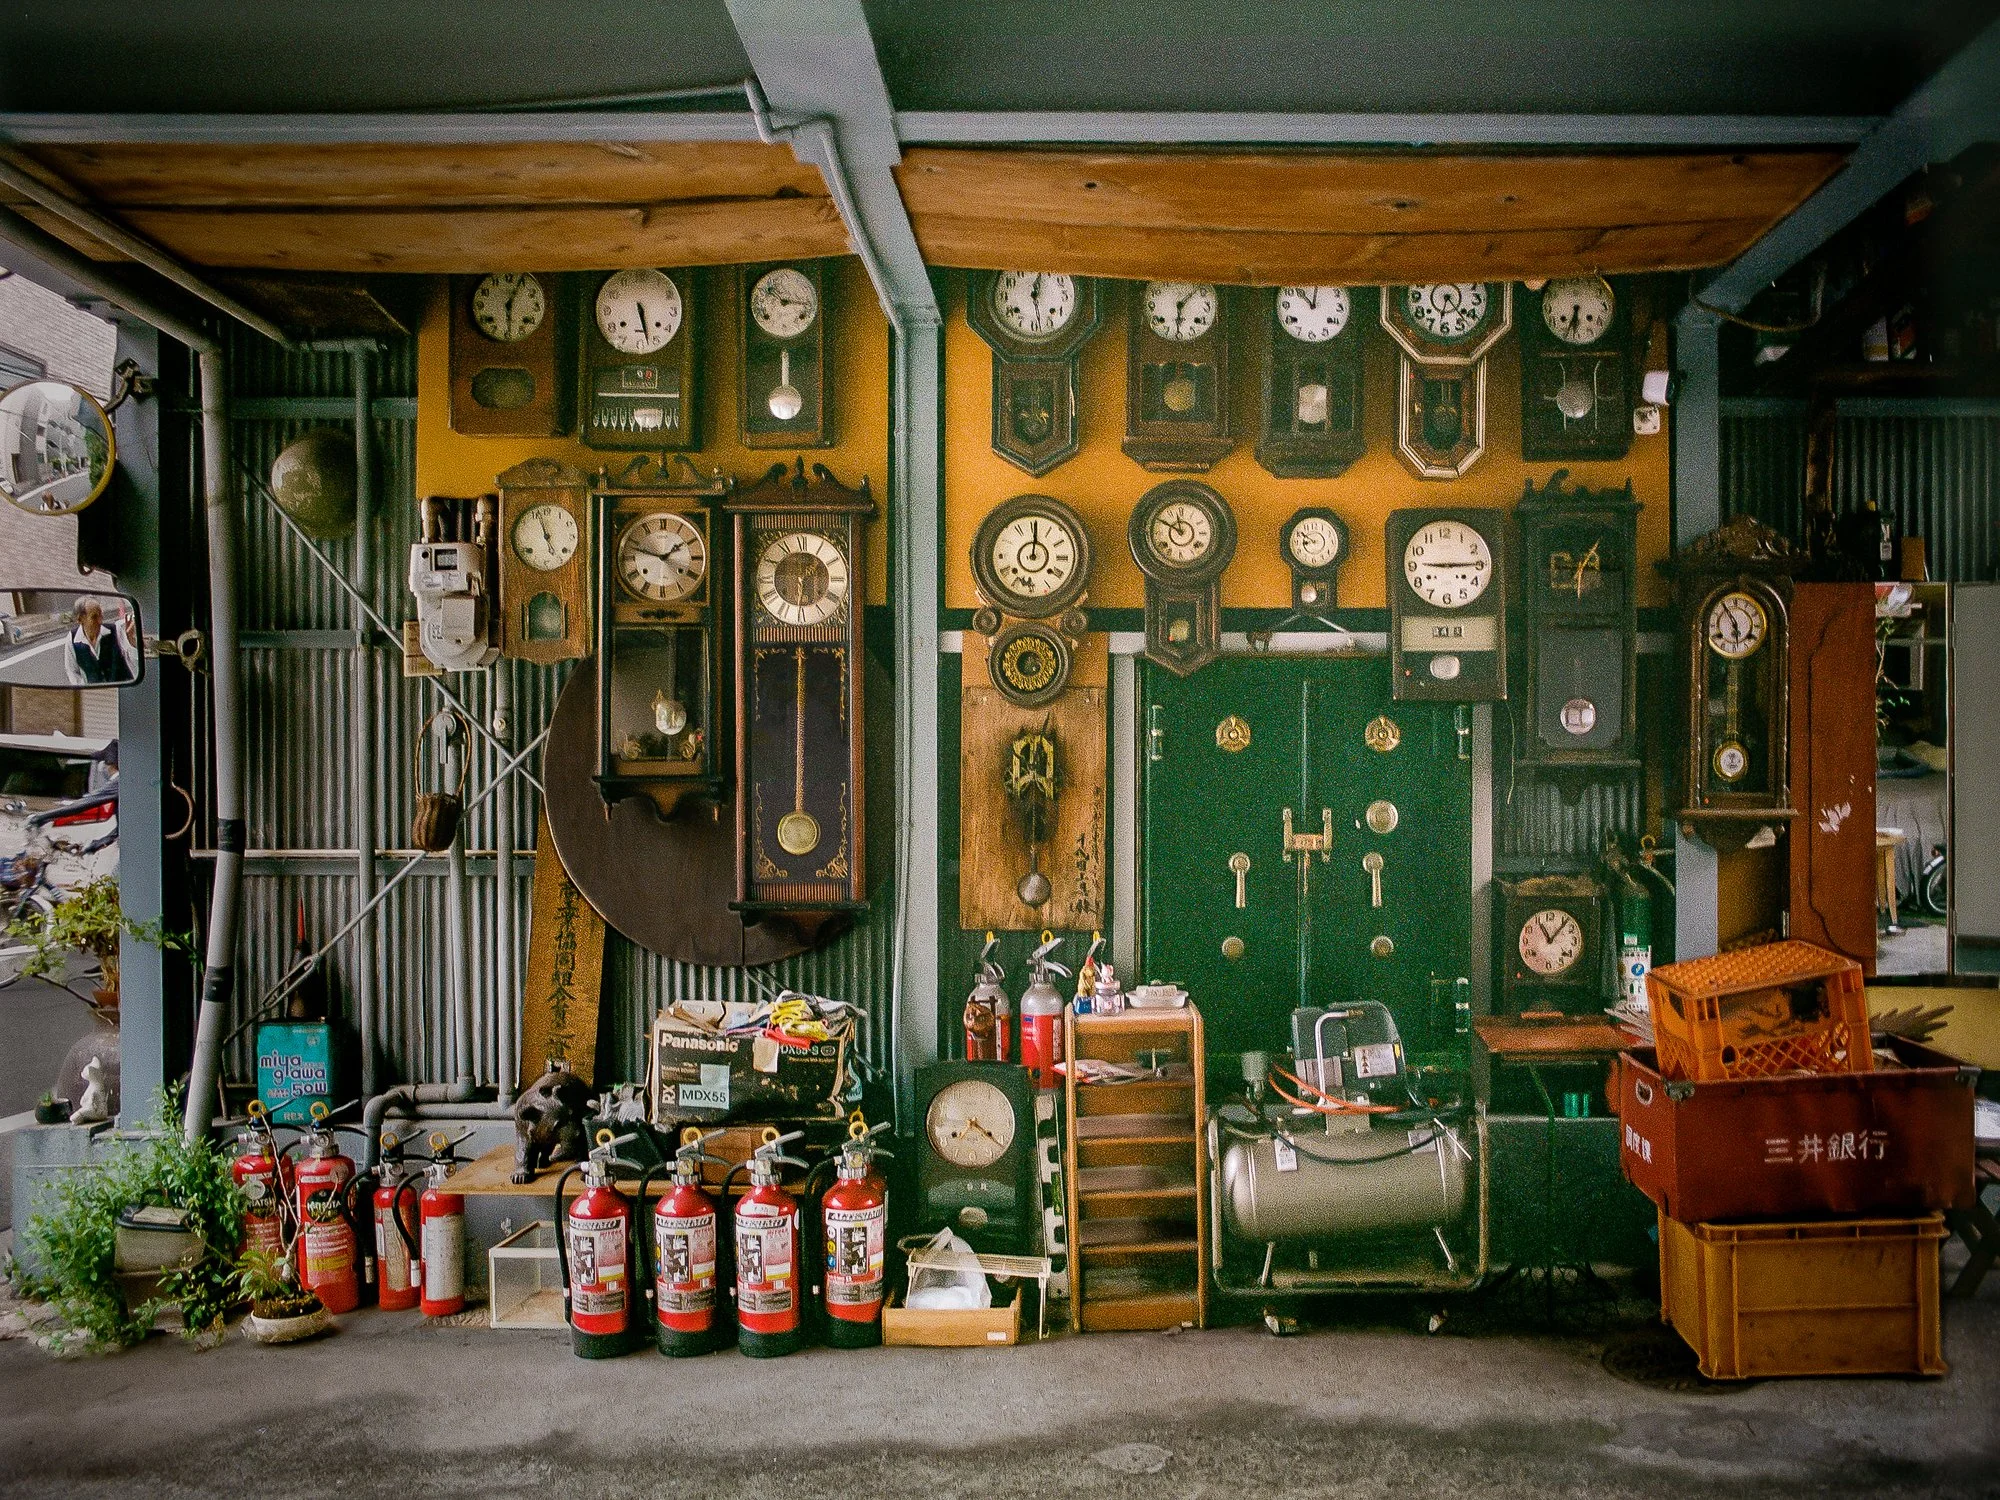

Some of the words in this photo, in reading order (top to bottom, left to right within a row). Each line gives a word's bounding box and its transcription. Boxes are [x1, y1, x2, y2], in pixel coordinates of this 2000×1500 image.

[1471, 292, 1482, 306] 3
[1414, 305, 1425, 320] 8
[1426, 316, 1436, 330] 7
[1440, 321, 1451, 335] 6
[1454, 317, 1466, 332] 5
[1424, 532, 1434, 544] 11
[1439, 527, 1452, 540] 12
[1460, 530, 1464, 544] 1
[1412, 545, 1425, 557] 10
[1469, 542, 1479, 556] 2
[1407, 560, 1418, 573] 9
[1474, 559, 1485, 571] 3
[1413, 576, 1423, 589] 8
[1470, 575, 1480, 587] 4
[1426, 588, 1436, 601] 7
[1442, 592, 1452, 606] 6
[1459, 587, 1469, 600] 5
[1545, 911, 1556, 923] 12
[1570, 935, 1578, 947] 3
[661, 1032, 740, 1053] Panasonic
[682, 1089, 727, 1104] MDX55
[1763, 1129, 1890, 1164] 三井銀行
